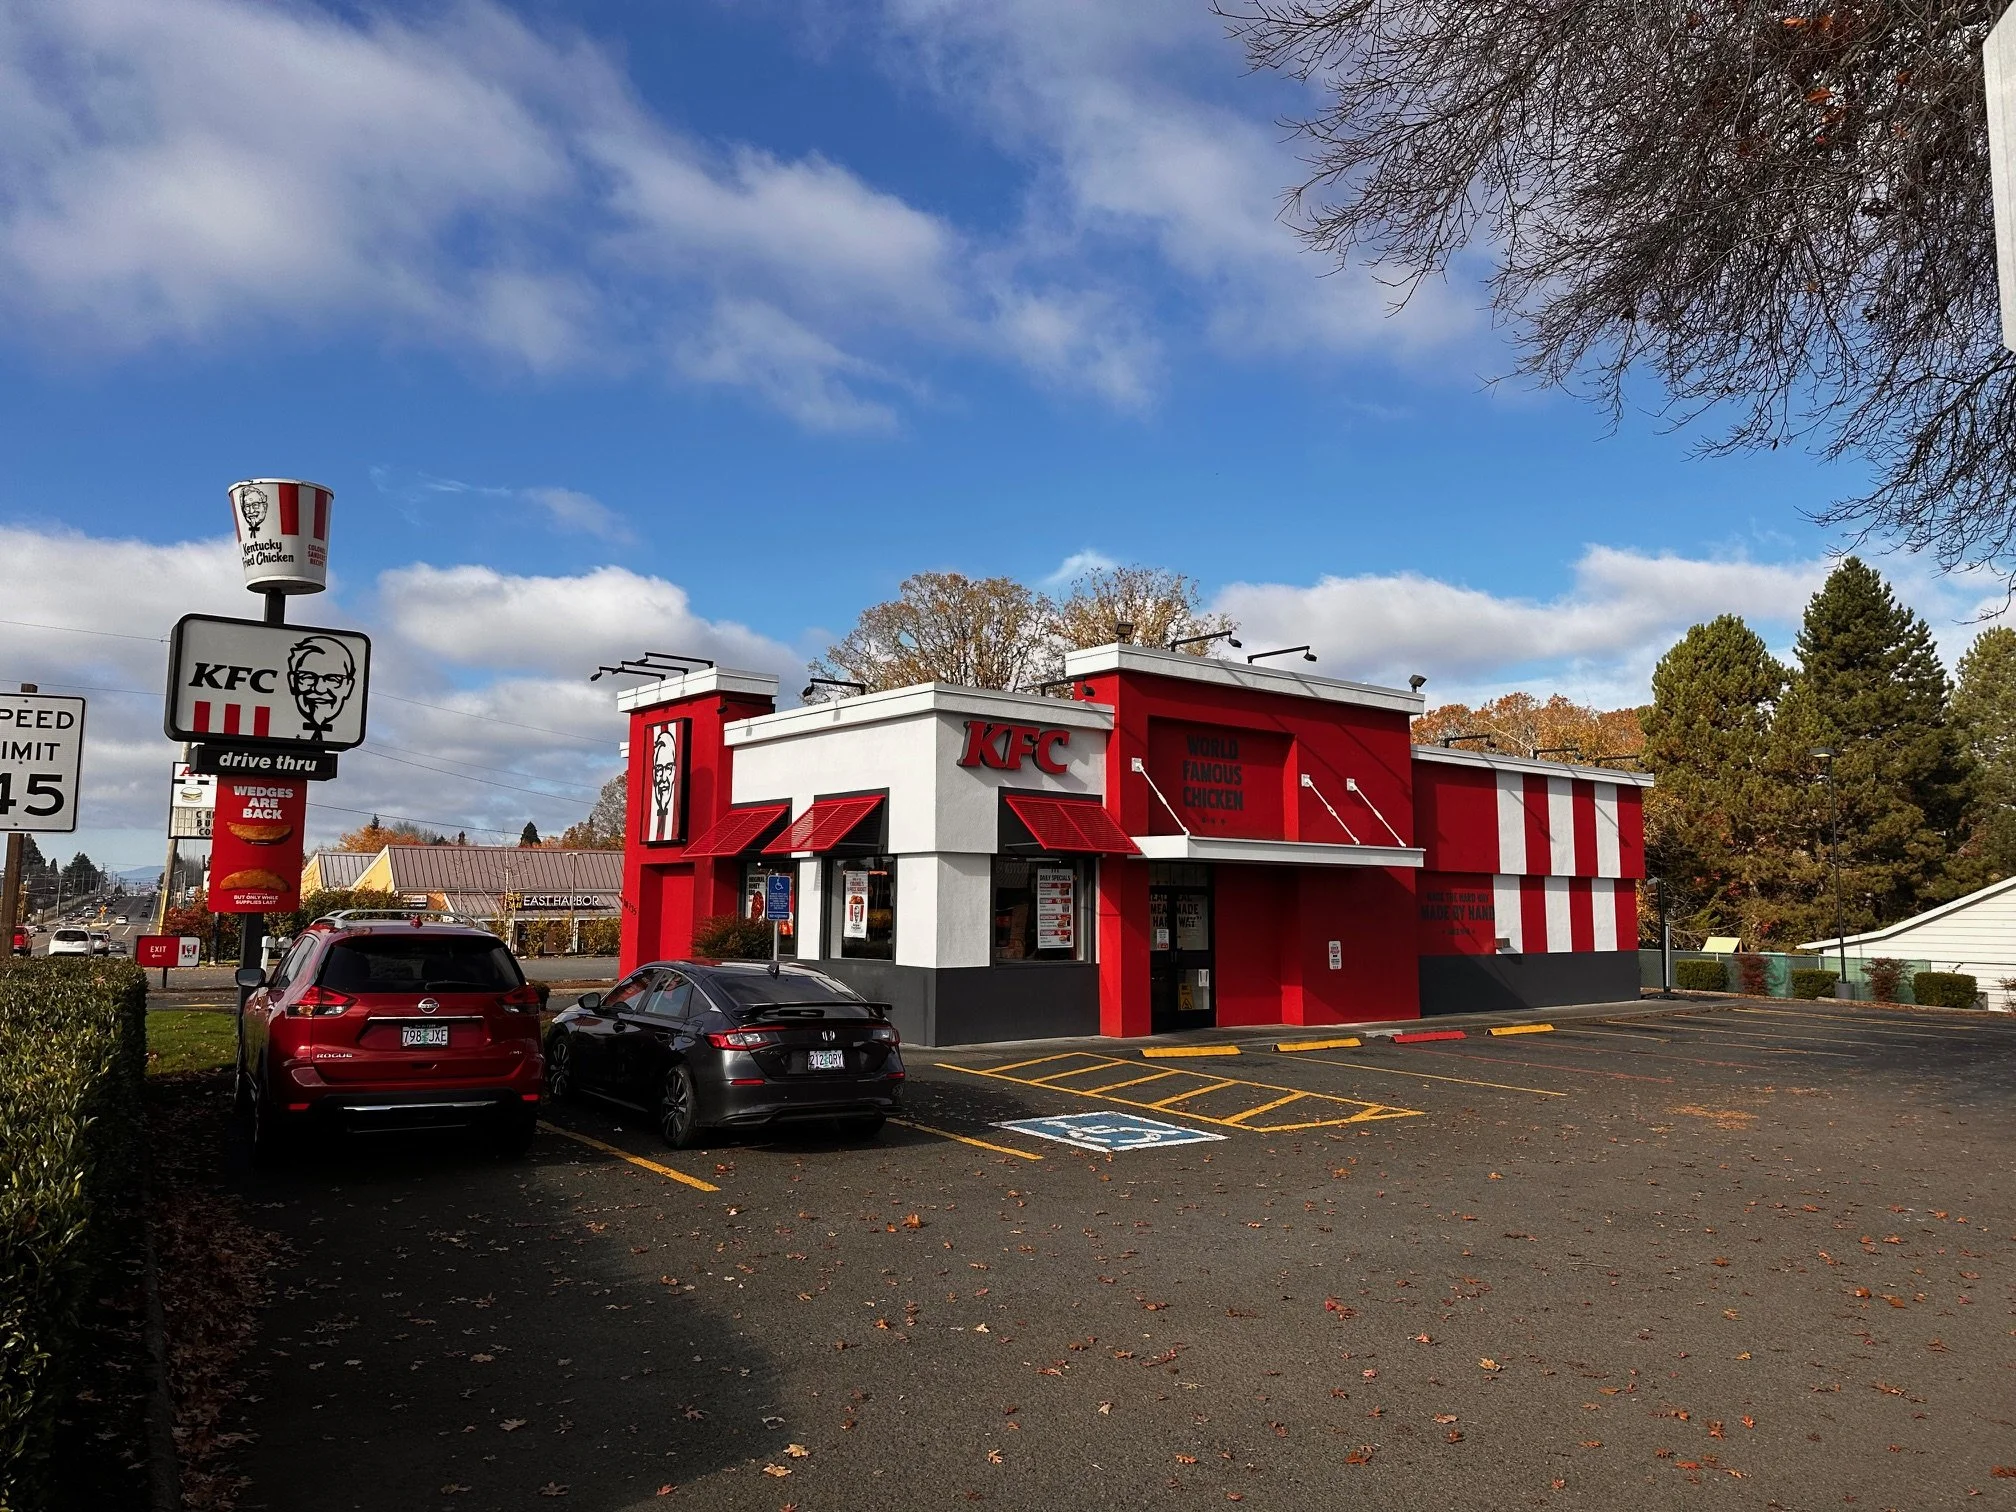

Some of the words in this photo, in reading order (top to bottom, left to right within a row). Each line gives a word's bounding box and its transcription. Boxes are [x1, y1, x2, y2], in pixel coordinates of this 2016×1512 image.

[243, 539, 282, 556] Kentucky
[256, 552, 294, 565] Chicken
[188, 662, 278, 694] KFC
[0, 708, 74, 729] PEED
[2, 741, 60, 761] IMIT
[957, 720, 1071, 774] KFC
[1187, 735, 1239, 759] WORLD
[219, 752, 271, 769] drive
[276, 754, 317, 771] thru
[1183, 760, 1242, 785] FAMOUS
[233, 785, 294, 798] WEDGES
[1183, 786, 1244, 811] CHICKEN
[248, 798, 279, 808] ARE
[242, 808, 282, 819] BACK
[523, 896, 552, 906] EAST
[554, 895, 599, 906] HARBOR
[1421, 905, 1448, 920] MADE
[1453, 905, 1465, 920] BY
[403, 1030, 422, 1042] 798
[428, 1029, 447, 1042] JXE
[809, 1054, 824, 1065] 212
